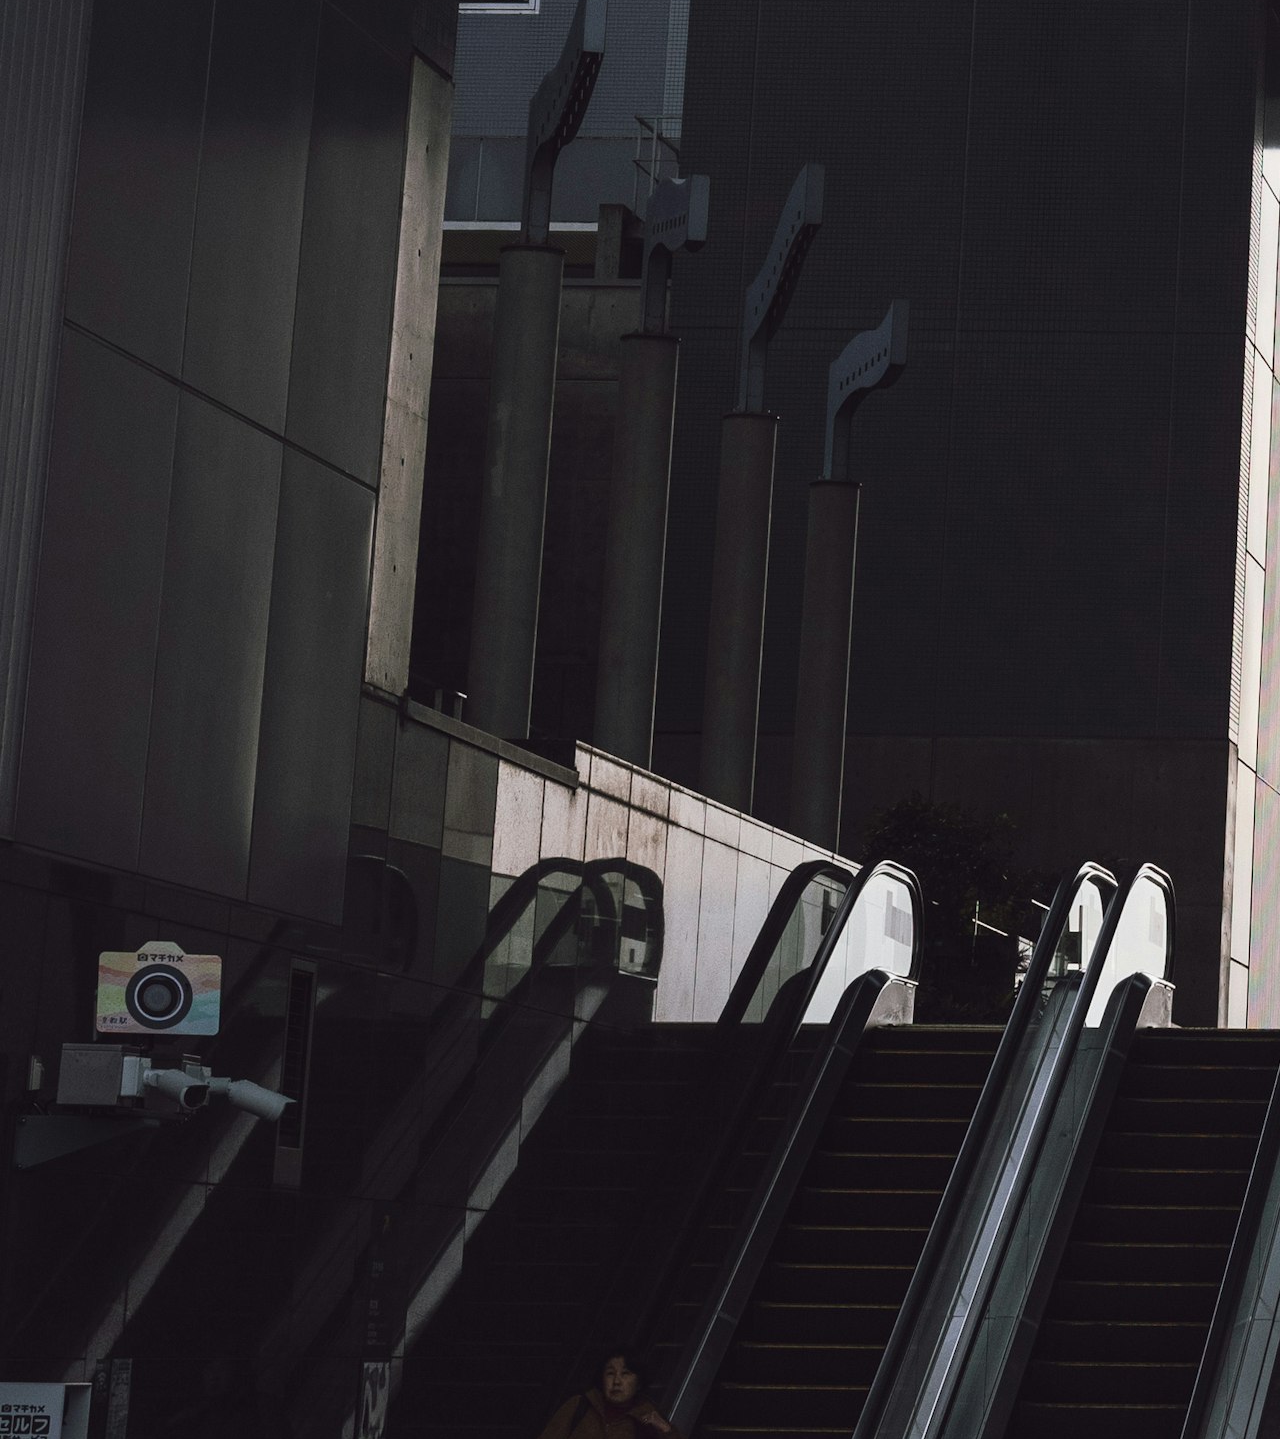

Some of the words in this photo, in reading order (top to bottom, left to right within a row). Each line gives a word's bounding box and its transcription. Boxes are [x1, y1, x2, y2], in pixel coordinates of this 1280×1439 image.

[149, 953, 184, 962] マチカメ
[13, 1404, 45, 1413] マチカメ
[0, 1416, 49, 1433] セルフ
